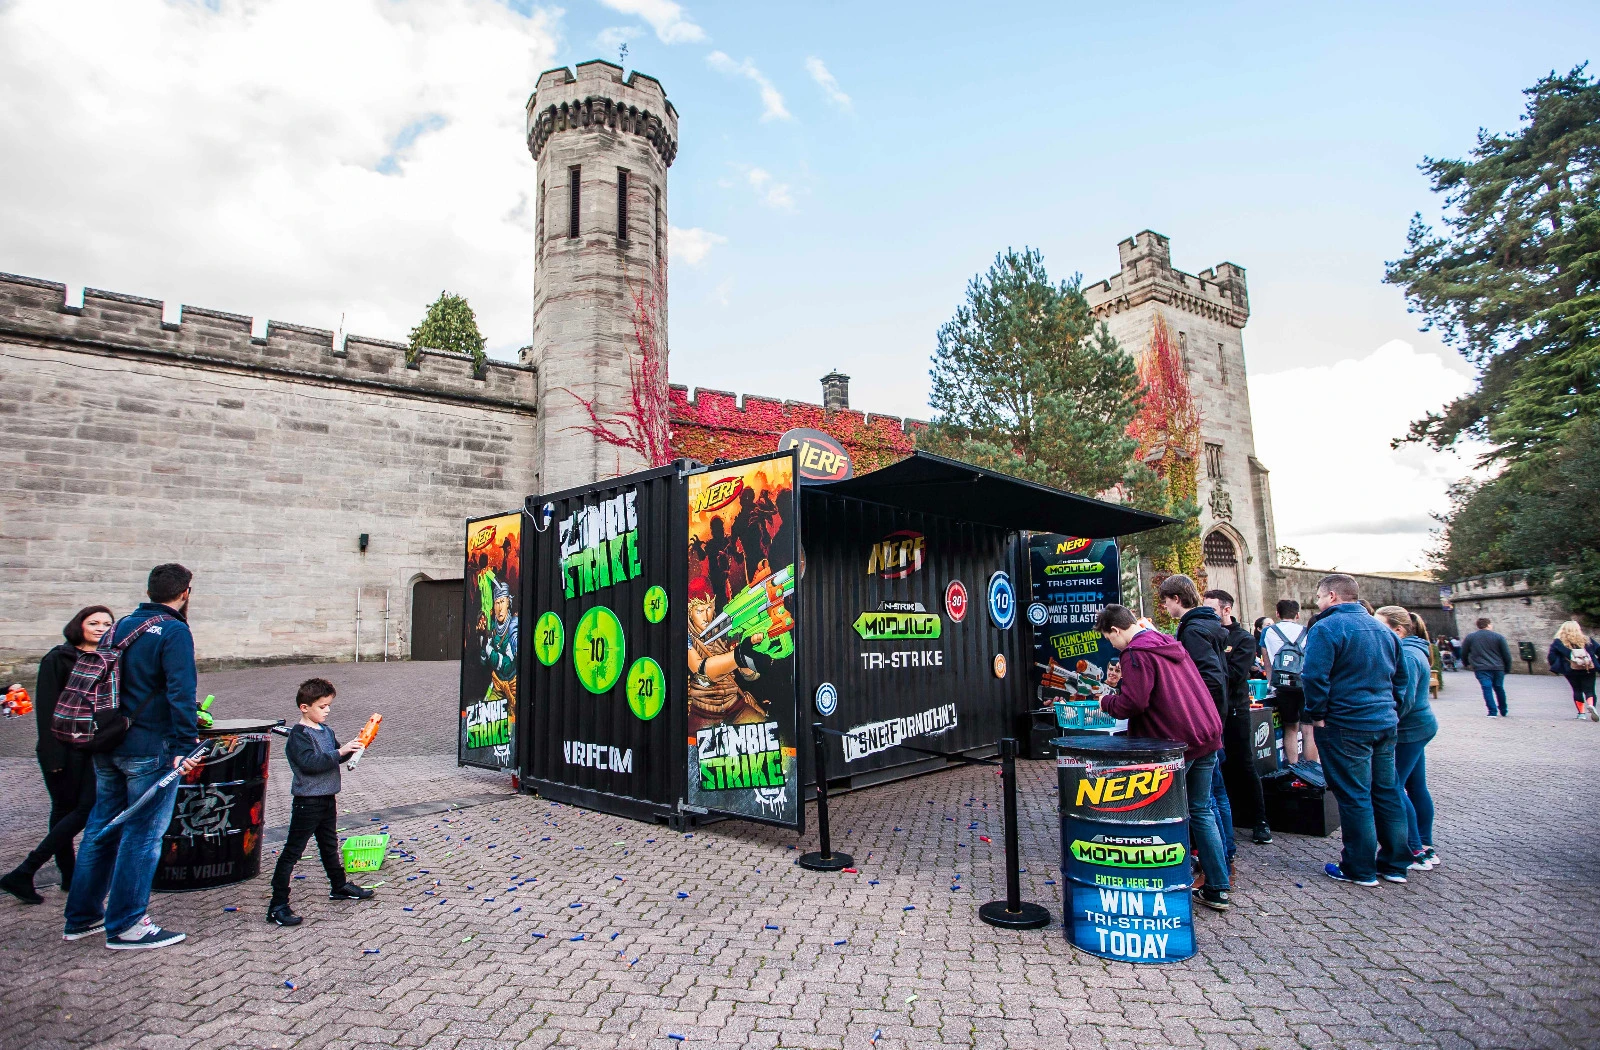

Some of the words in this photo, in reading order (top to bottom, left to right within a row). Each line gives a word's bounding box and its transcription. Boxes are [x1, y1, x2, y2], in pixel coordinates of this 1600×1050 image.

[789, 439, 848, 474] NERF
[695, 476, 744, 513] NERF
[471, 525, 497, 551] NERF
[1056, 537, 1091, 554] NERF
[564, 528, 642, 600] STRIKE
[867, 536, 925, 575] NERF
[1049, 563, 1098, 575] MODULUS
[1047, 578, 1103, 588] TRI-STRIKE
[650, 598, 660, 610] 50
[884, 602, 917, 611] N-STRIK
[951, 595, 962, 606] 30
[995, 593, 1009, 609] 10
[1048, 604, 1068, 614] WAYS
[1070, 604, 1080, 613] TO
[1082, 603, 1104, 613] BUILD
[865, 617, 934, 635] MODULUS
[1048, 614, 1068, 624] YOUR
[1070, 613, 1098, 623] BLASTE
[543, 630, 555, 646] 20
[1053, 630, 1102, 648] LAUNCHING
[590, 637, 605, 663] 10
[1060, 642, 1097, 657] 26.08.16
[860, 650, 943, 670] TRI-STRIKE
[638, 678, 653, 697] 20
[466, 699, 508, 727] ZOMBIE
[468, 719, 509, 748] STRIKE
[697, 721, 780, 759] ZOMBIE
[868, 721, 899, 750] NERF
[901, 716, 916, 739] OR
[700, 751, 785, 790] STRIKE
[1075, 767, 1169, 806] NERF
[1104, 836, 1153, 845] N-STRIKE
[1079, 844, 1178, 865] MODULUS
[164, 866, 187, 880] THE
[193, 861, 235, 879] VAULT
[1095, 874, 1123, 888] ENTER
[1126, 878, 1150, 889] HERE
[1152, 878, 1164, 889] TO
[1099, 888, 1144, 916] WIN
[1152, 892, 1168, 917] A
[1084, 910, 1181, 931] TRI-STRIKE
[1095, 927, 1169, 959] TODAY
